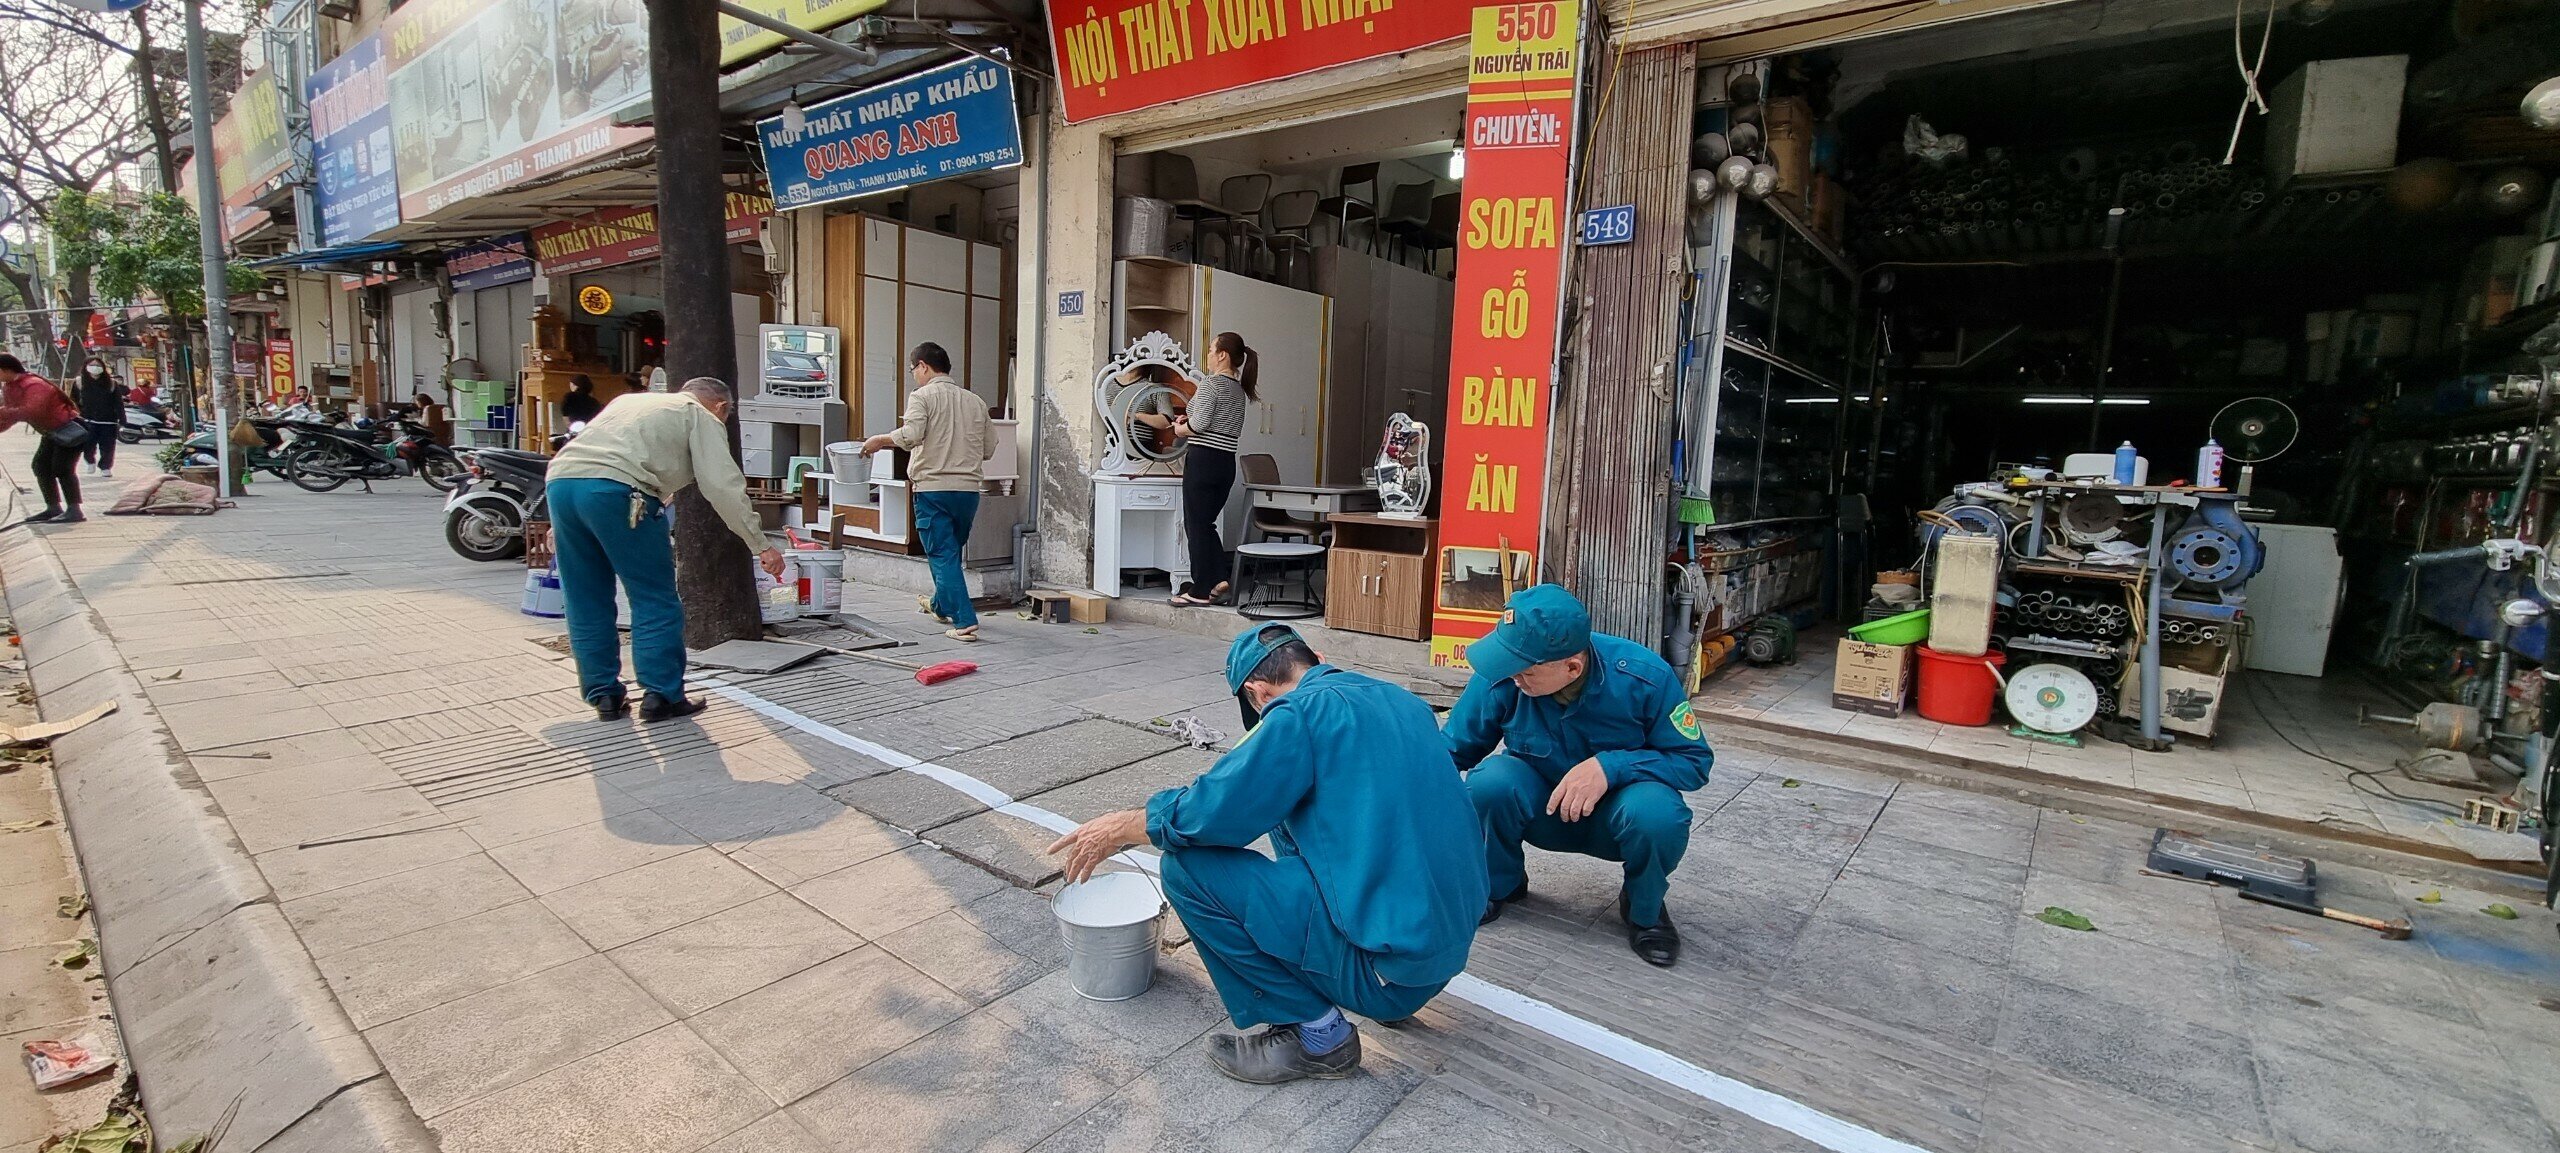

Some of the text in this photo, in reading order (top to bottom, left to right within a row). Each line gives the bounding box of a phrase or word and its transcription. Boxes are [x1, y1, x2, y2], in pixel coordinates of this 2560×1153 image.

[1496, 4, 1557, 43] 550
[1065, 6, 1118, 97] NỘI
[1474, 47, 1570, 75] NGUYỄN TRÃI
[804, 106, 853, 139] THẤT
[858, 91, 920, 125] NHẬP
[927, 64, 998, 106] KHẨU
[1472, 108, 1561, 146] CHUYÊN:
[533, 142, 571, 172] THANH
[574, 126, 611, 157] XUÂN
[804, 111, 960, 180] QUANG ANH
[790, 185, 809, 202] 552
[810, 180, 839, 198] NGUYỄN
[840, 179, 855, 192] TRÃI
[860, 175, 886, 188] THANH
[886, 167, 909, 183] XUÂN
[910, 160, 928, 178] BẮC
[955, 154, 977, 168] 0904
[979, 151, 995, 163] 798
[537, 232, 560, 264] NỘI
[558, 221, 590, 255] THẤT
[618, 212, 655, 242] MINH
[1466, 196, 1556, 250] SOFA
[1586, 210, 1630, 241] 548
[1060, 294, 1082, 312] 550
[1480, 269, 1530, 339] GỖ
[1461, 366, 1537, 428] BÀN
[1466, 452, 1518, 514] ĂN
